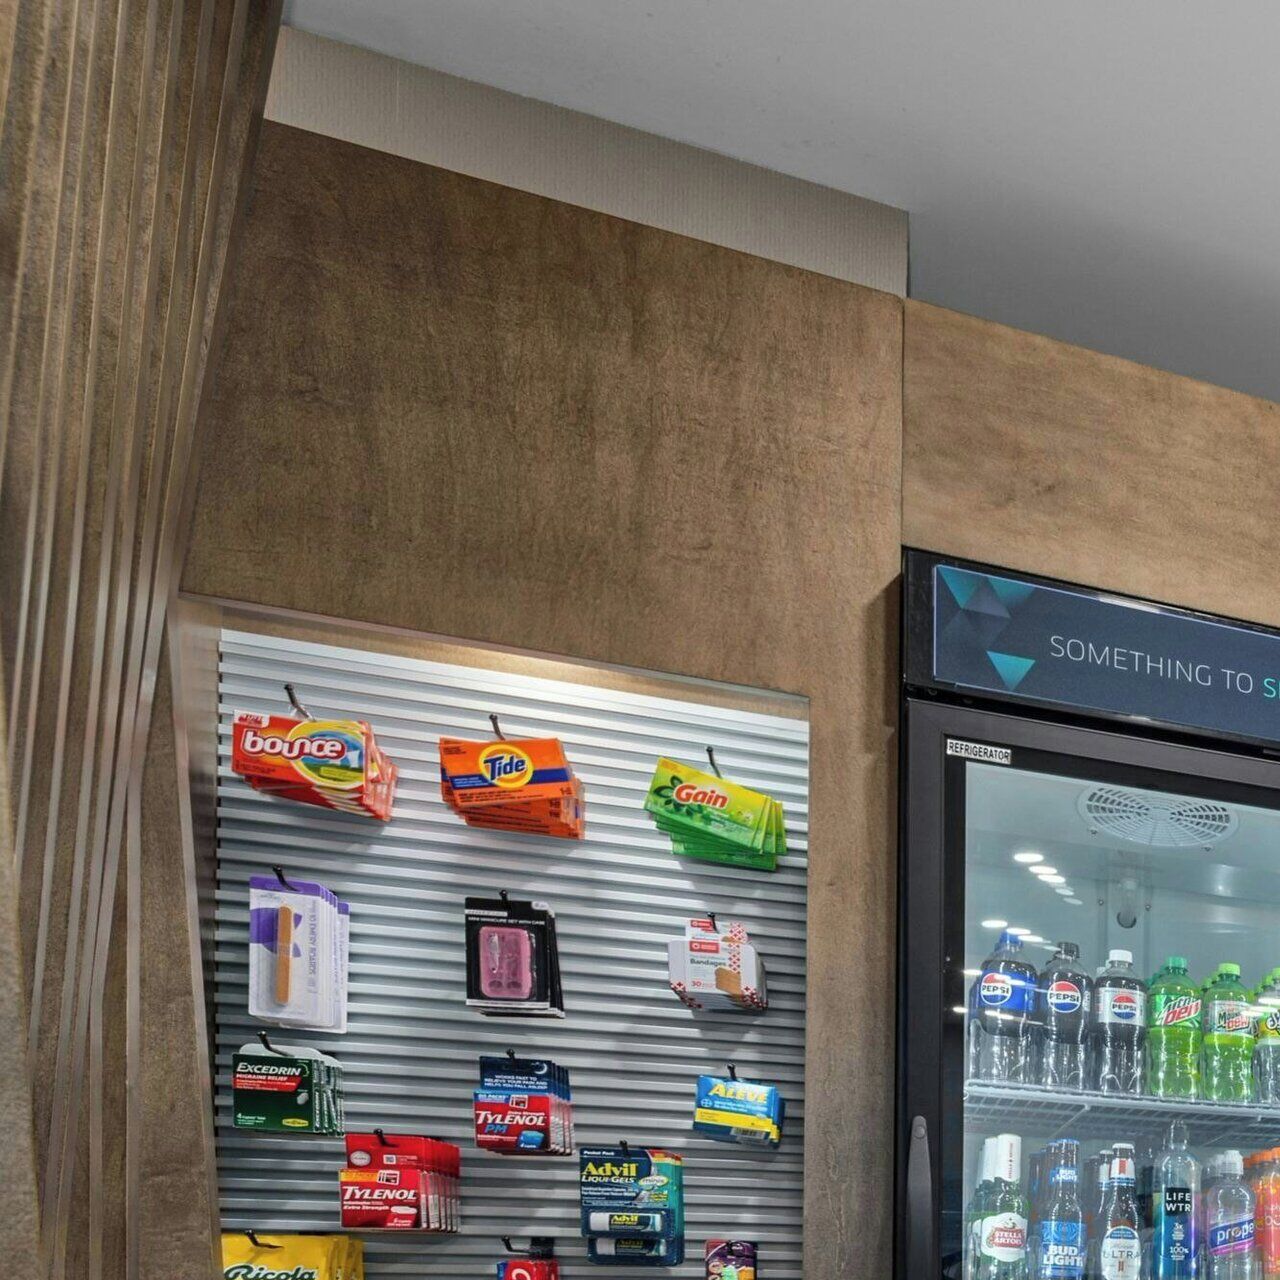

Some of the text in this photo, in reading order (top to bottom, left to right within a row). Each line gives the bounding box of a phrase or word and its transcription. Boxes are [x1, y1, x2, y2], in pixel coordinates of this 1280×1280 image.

[1050, 635, 1212, 687] SOMETHING
[1221, 668, 1253, 693] TO
[244, 731, 344, 759] bounce
[948, 740, 1011, 762] REFRIGERATOR
[484, 756, 527, 781] Tide
[674, 783, 729, 809] Gain
[982, 986, 1010, 994] PEPSI
[1049, 992, 1079, 1002] PEPSI
[1112, 1003, 1137, 1011] PEPSI
[236, 1062, 301, 1076] EXCEDRIN
[475, 1110, 546, 1126] TYLENOL
[485, 1124, 508, 1133] PM
[582, 1162, 638, 1177] Advil
[342, 1186, 418, 1200] TYLENOL
[1166, 1192, 1192, 1201] LIFE
[1165, 1203, 1192, 1212] WTR
[1047, 1245, 1078, 1256] BUD
[1043, 1255, 1084, 1267] LIGHT
